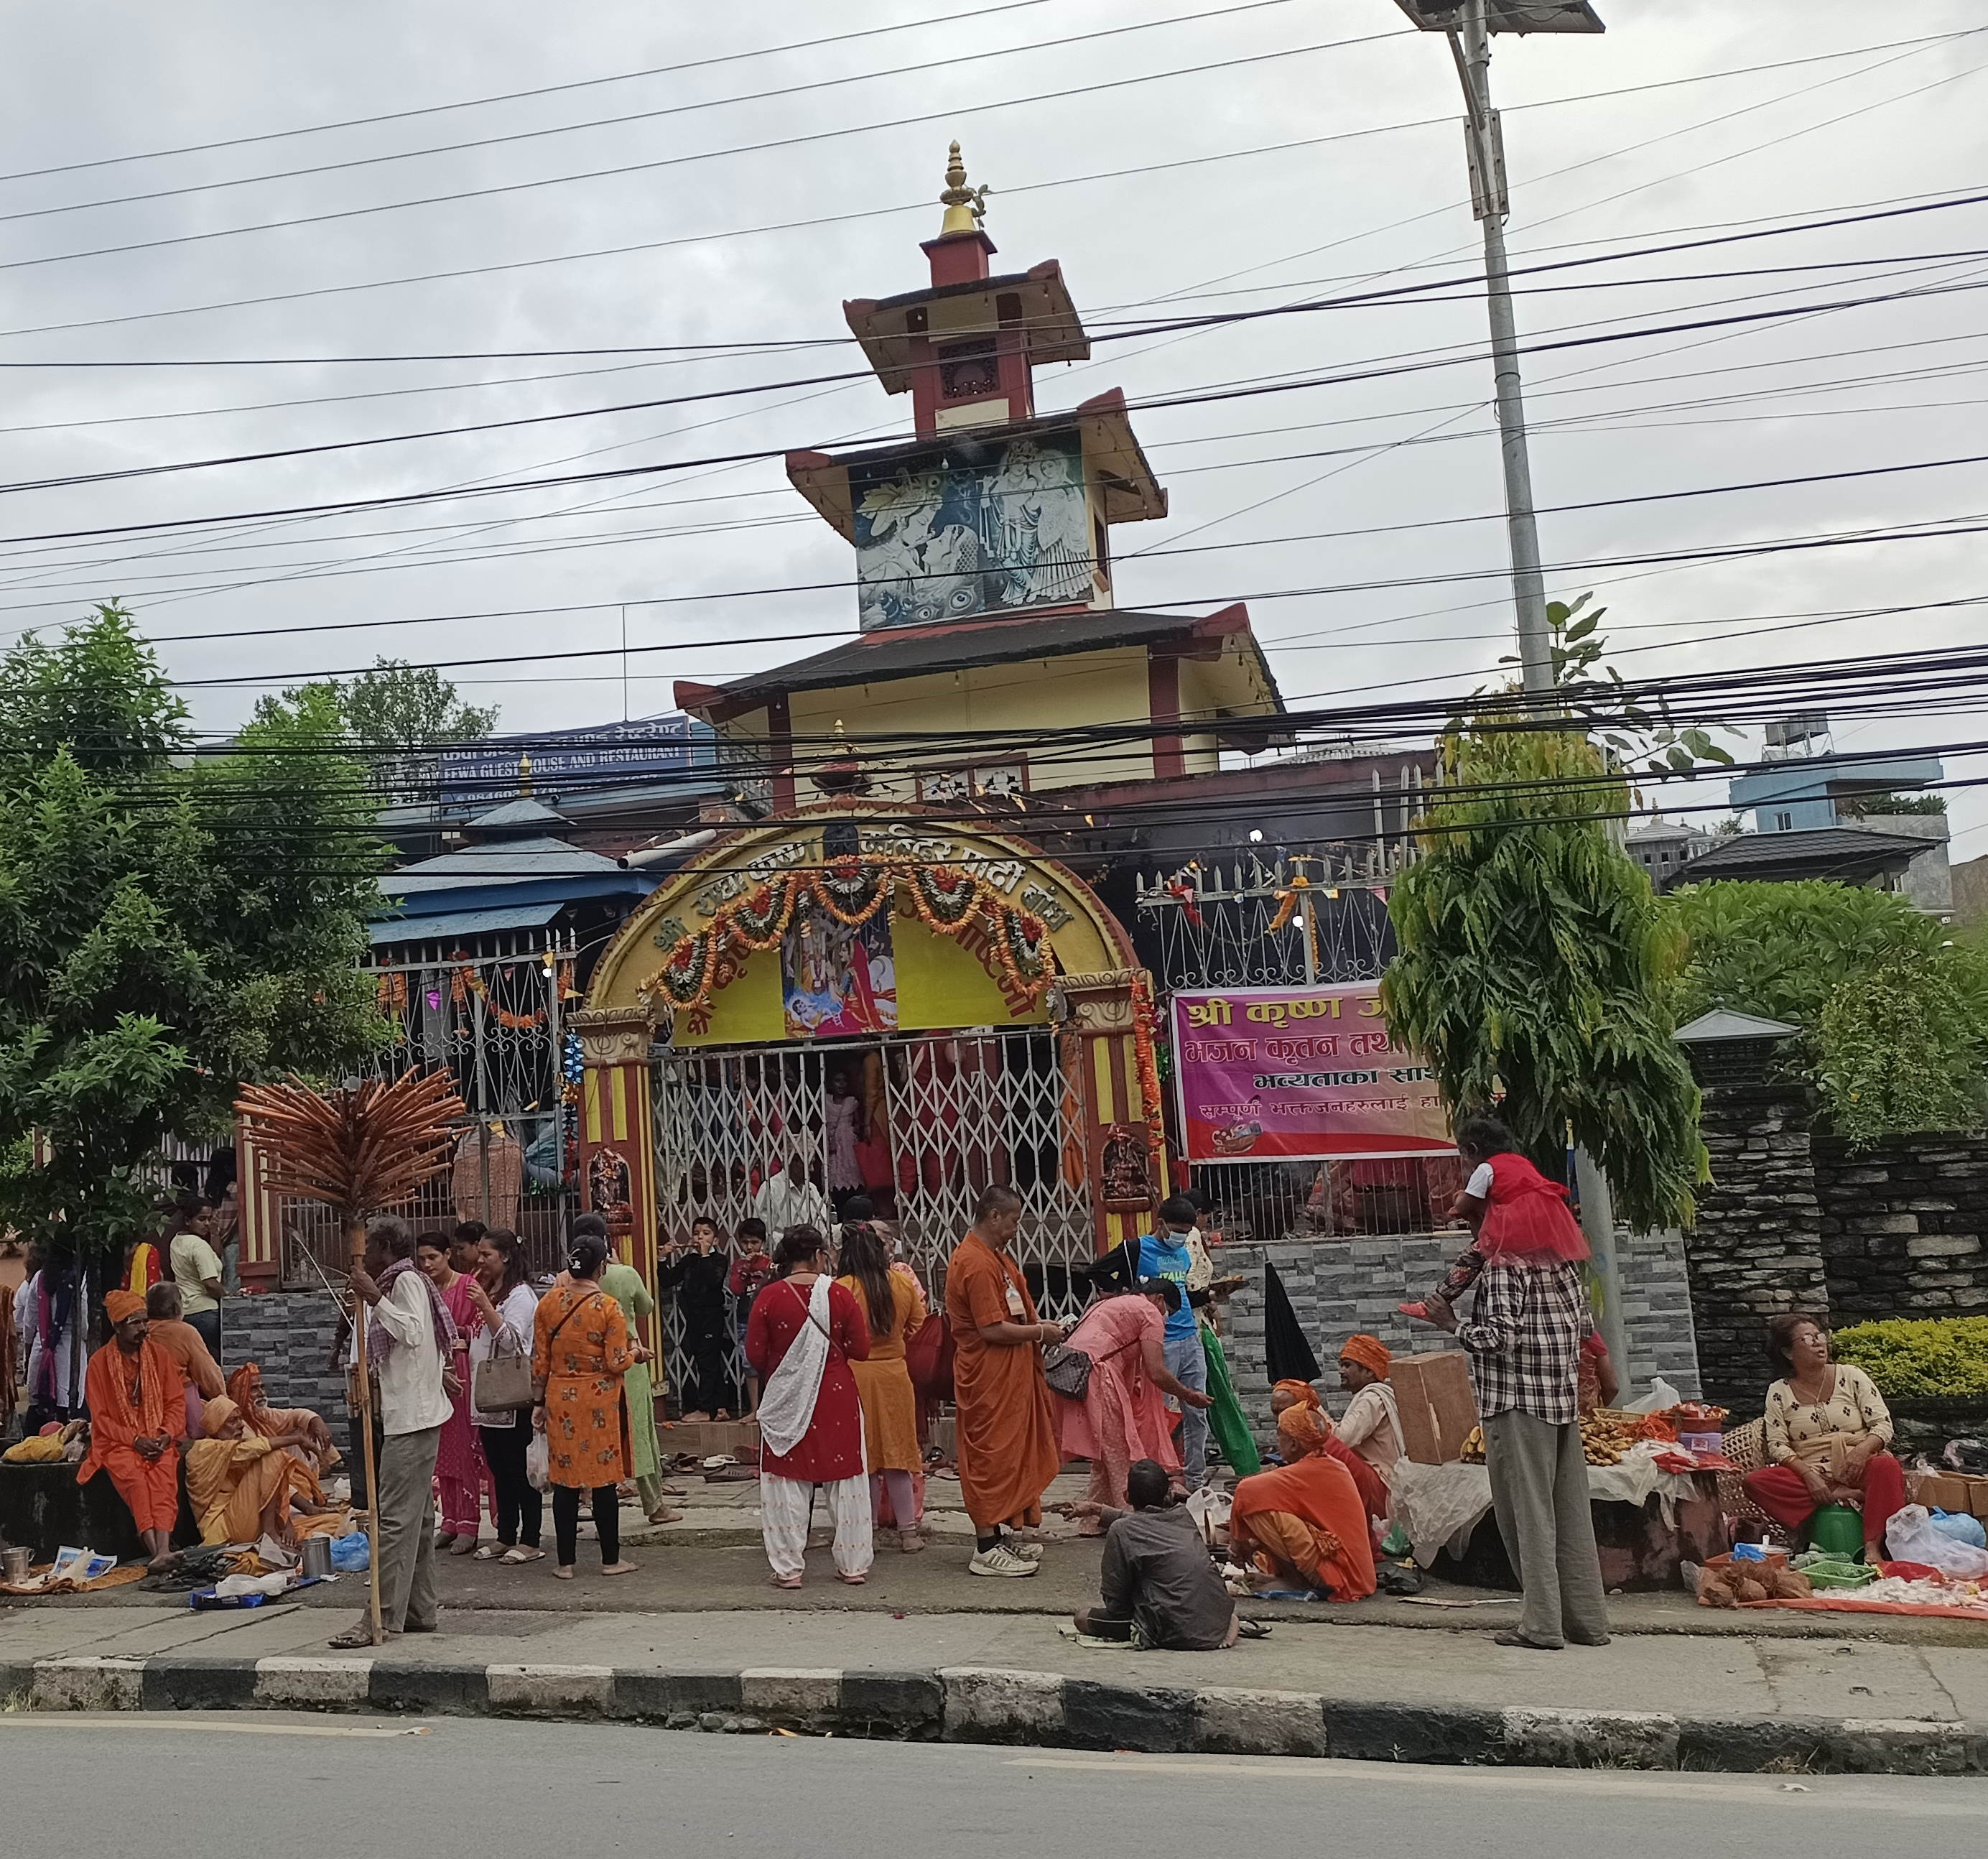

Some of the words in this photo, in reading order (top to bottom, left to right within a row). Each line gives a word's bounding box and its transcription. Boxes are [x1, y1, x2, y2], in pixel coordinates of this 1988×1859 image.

[480, 761, 520, 777] GUEST
[570, 752, 595, 769] AND
[599, 746, 679, 765] RESTAURANT
[860, 823, 959, 866] मन्दिर
[1186, 997, 1234, 1028] श्री
[1245, 997, 1343, 1028] कृष्ण
[1185, 1039, 1258, 1062] भजन
[1253, 1070, 1379, 1090] भव्यताका
[1199, 1099, 1263, 1121] सम्पूर्ण
